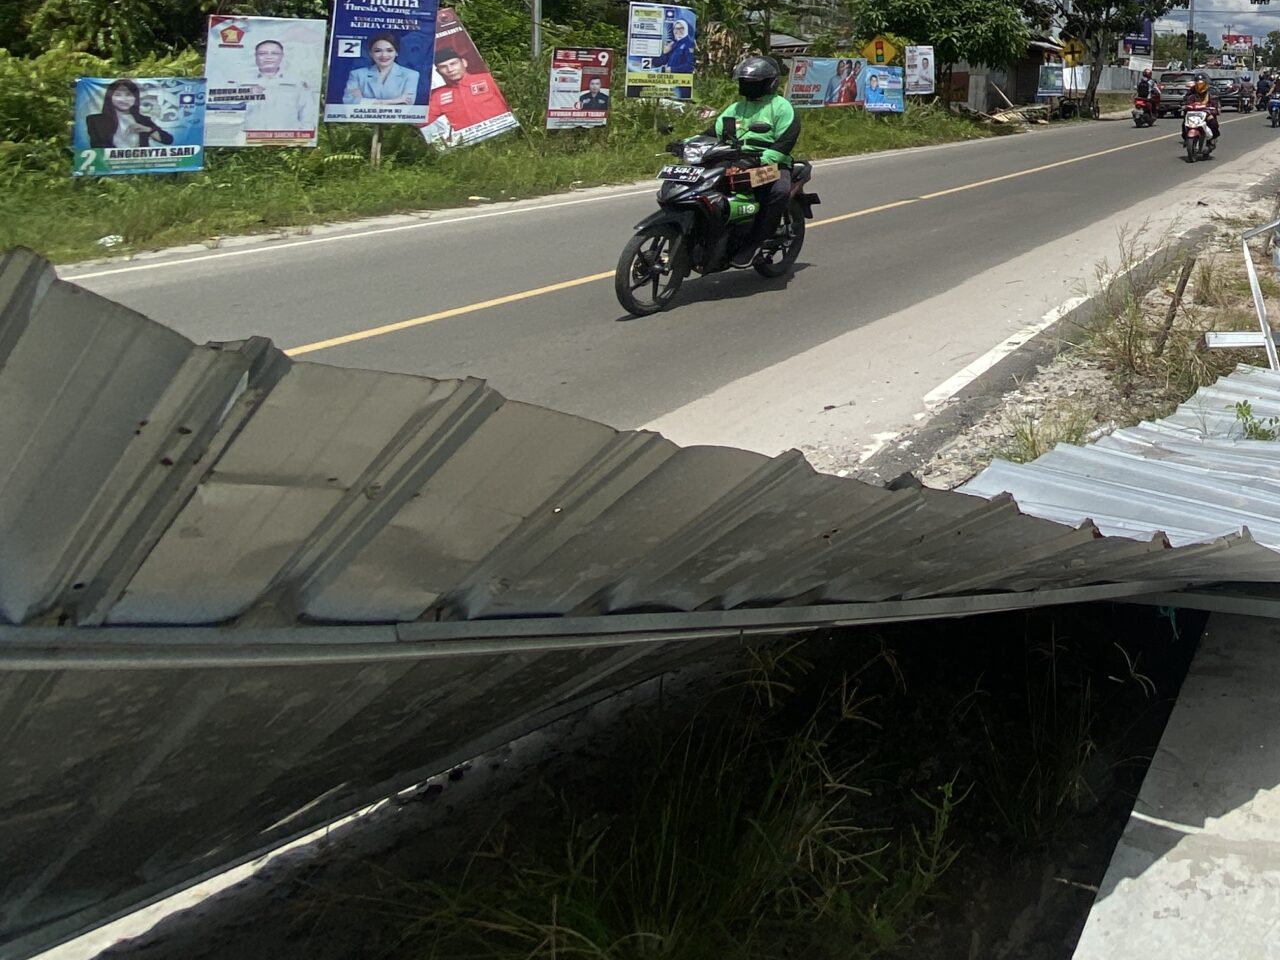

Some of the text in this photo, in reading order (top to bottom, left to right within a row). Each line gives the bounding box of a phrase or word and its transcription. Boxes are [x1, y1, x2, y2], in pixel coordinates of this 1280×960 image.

[344, 3, 378, 12] Thresia
[379, 6, 411, 15] Narang
[350, 21, 380, 29] KERJA
[598, 52, 609, 66] 9
[642, 60, 651, 69] 2
[109, 147, 195, 159] ANGGRYTA SARI
